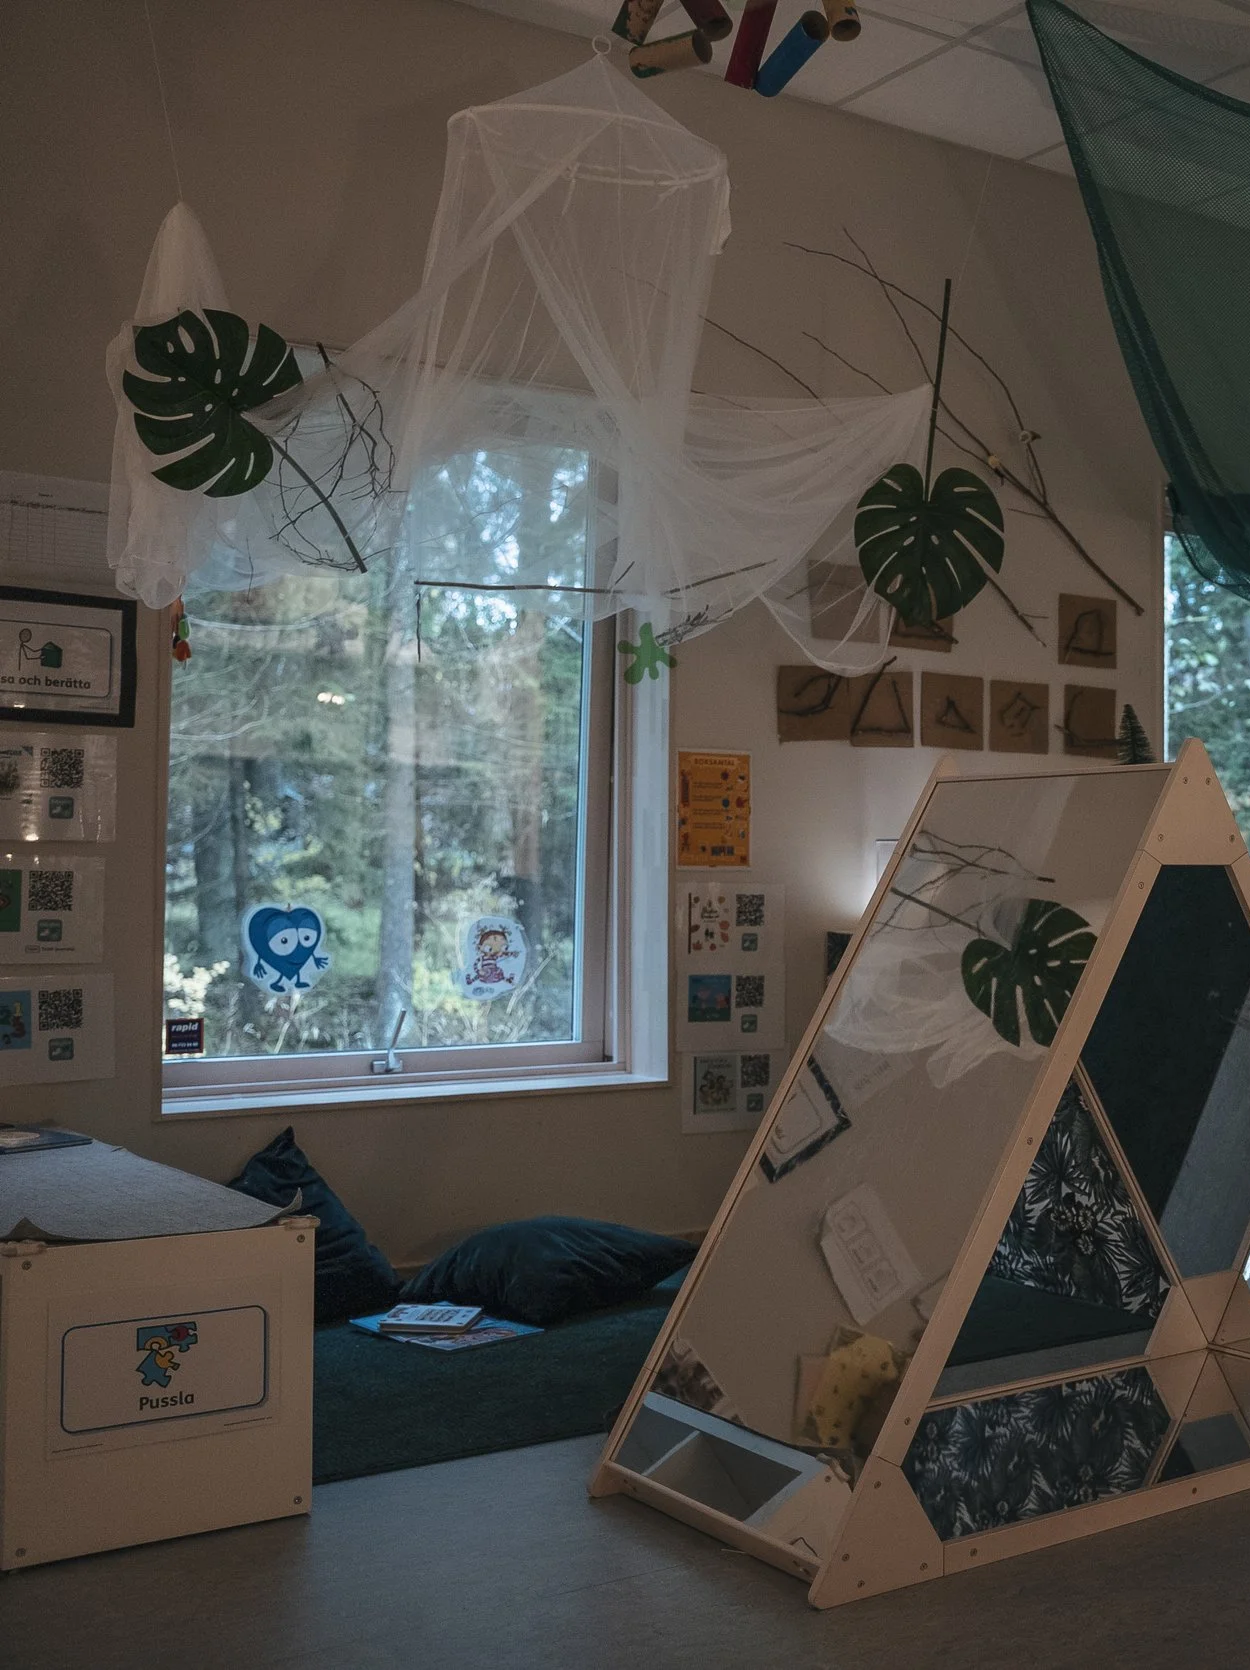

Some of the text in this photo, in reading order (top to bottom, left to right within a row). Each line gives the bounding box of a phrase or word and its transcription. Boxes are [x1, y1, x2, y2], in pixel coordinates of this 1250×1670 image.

[19, 675, 41, 686] och
[45, 676, 91, 689] berätta
[171, 1022, 199, 1032] rapid
[139, 1391, 194, 1410] Pussla
